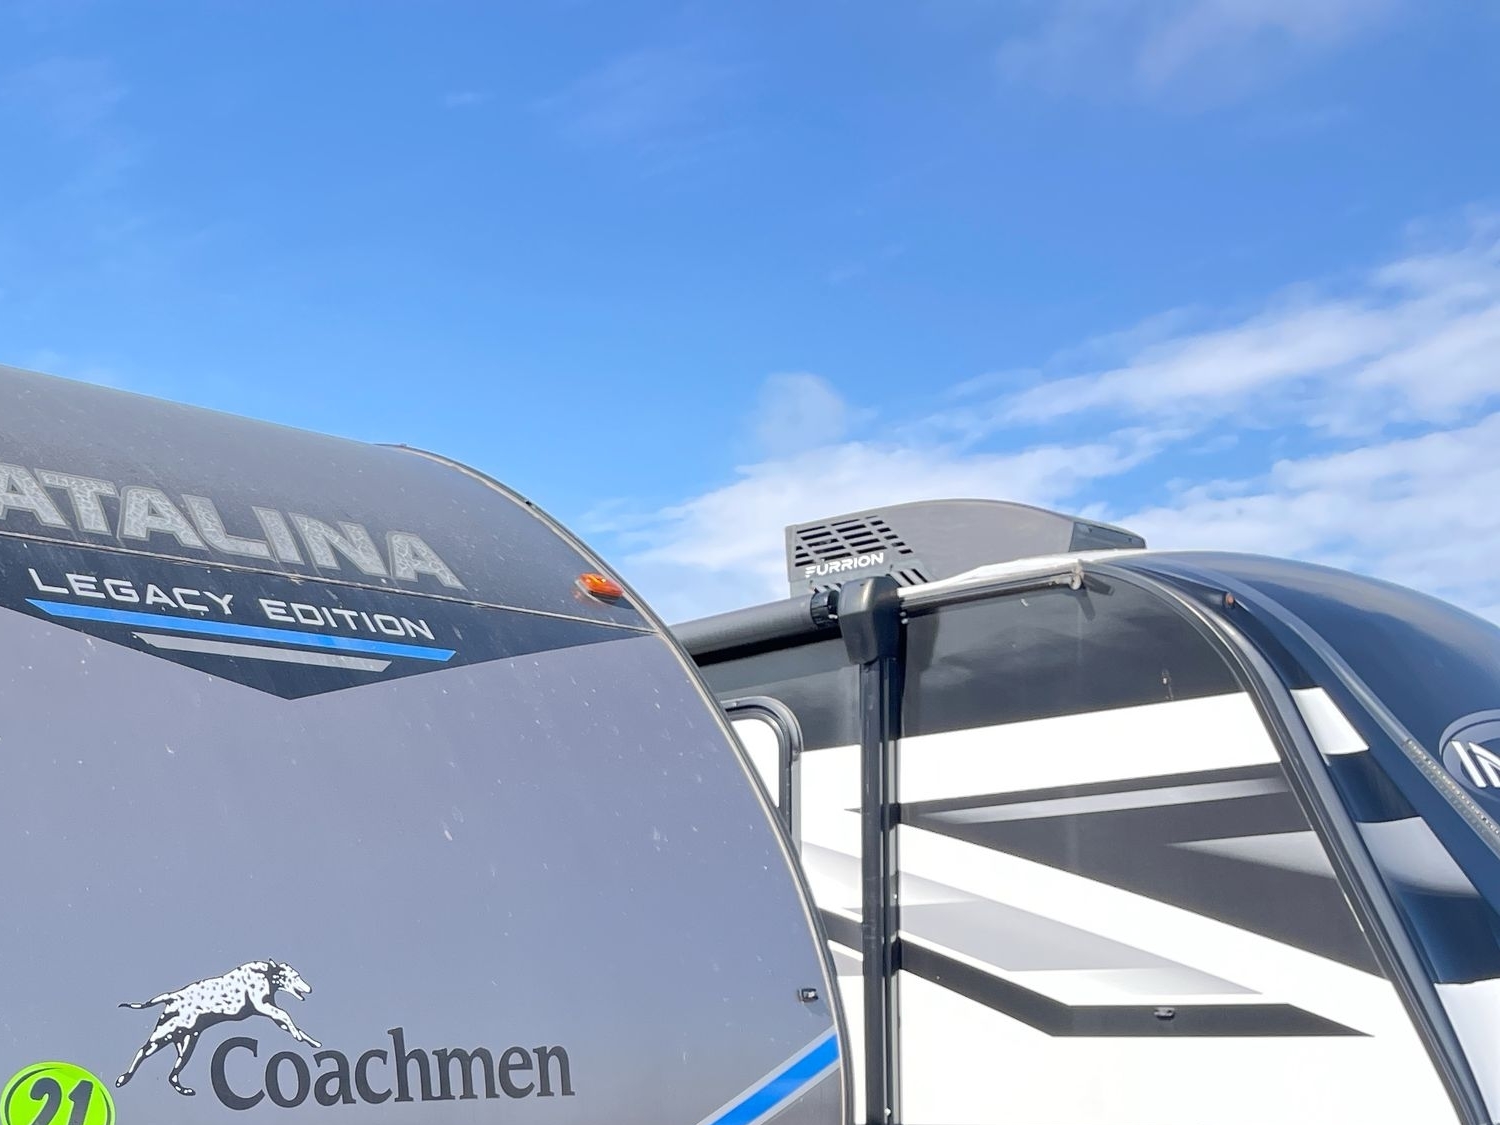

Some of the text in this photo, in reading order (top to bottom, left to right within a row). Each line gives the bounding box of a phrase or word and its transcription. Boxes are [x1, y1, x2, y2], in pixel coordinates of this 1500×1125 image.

[805, 552, 884, 578] FURRION
[28, 567, 436, 641] LEGACY EDITION
[210, 1027, 576, 1111] Coachmen
